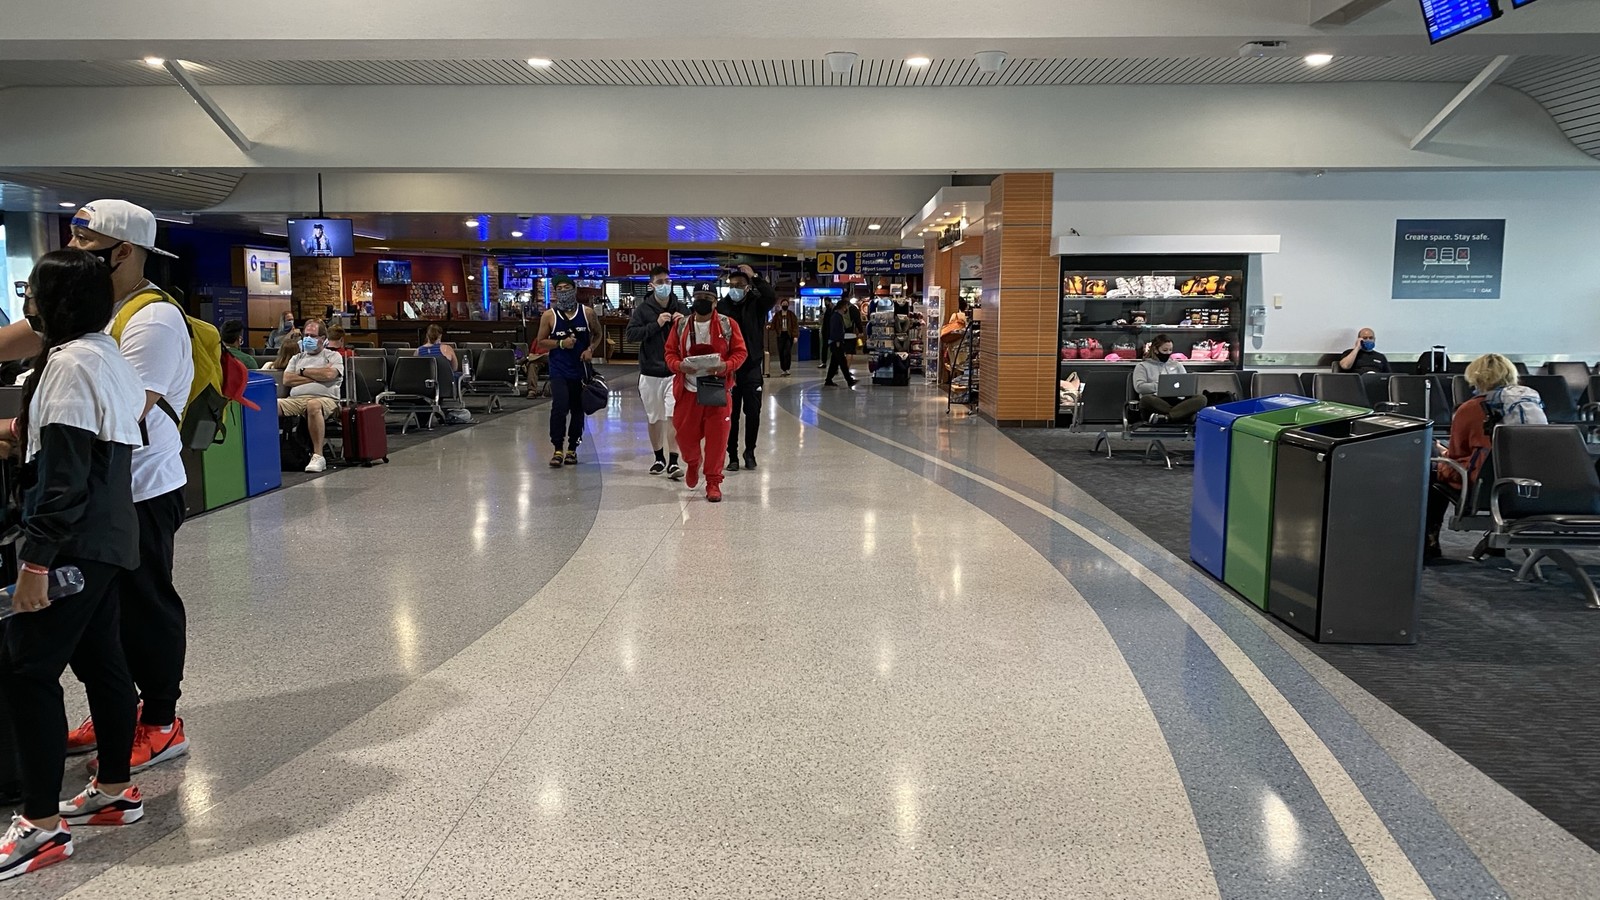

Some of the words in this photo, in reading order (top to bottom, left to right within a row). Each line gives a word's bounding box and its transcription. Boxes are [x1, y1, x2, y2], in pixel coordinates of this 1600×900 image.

[1429, 234, 1453, 242] space.
[1454, 233, 1471, 242] Stay
[1472, 233, 1490, 241] safe.
[250, 254, 258, 272] 6
[616, 251, 637, 265] tap
[836, 253, 848, 272] 6
